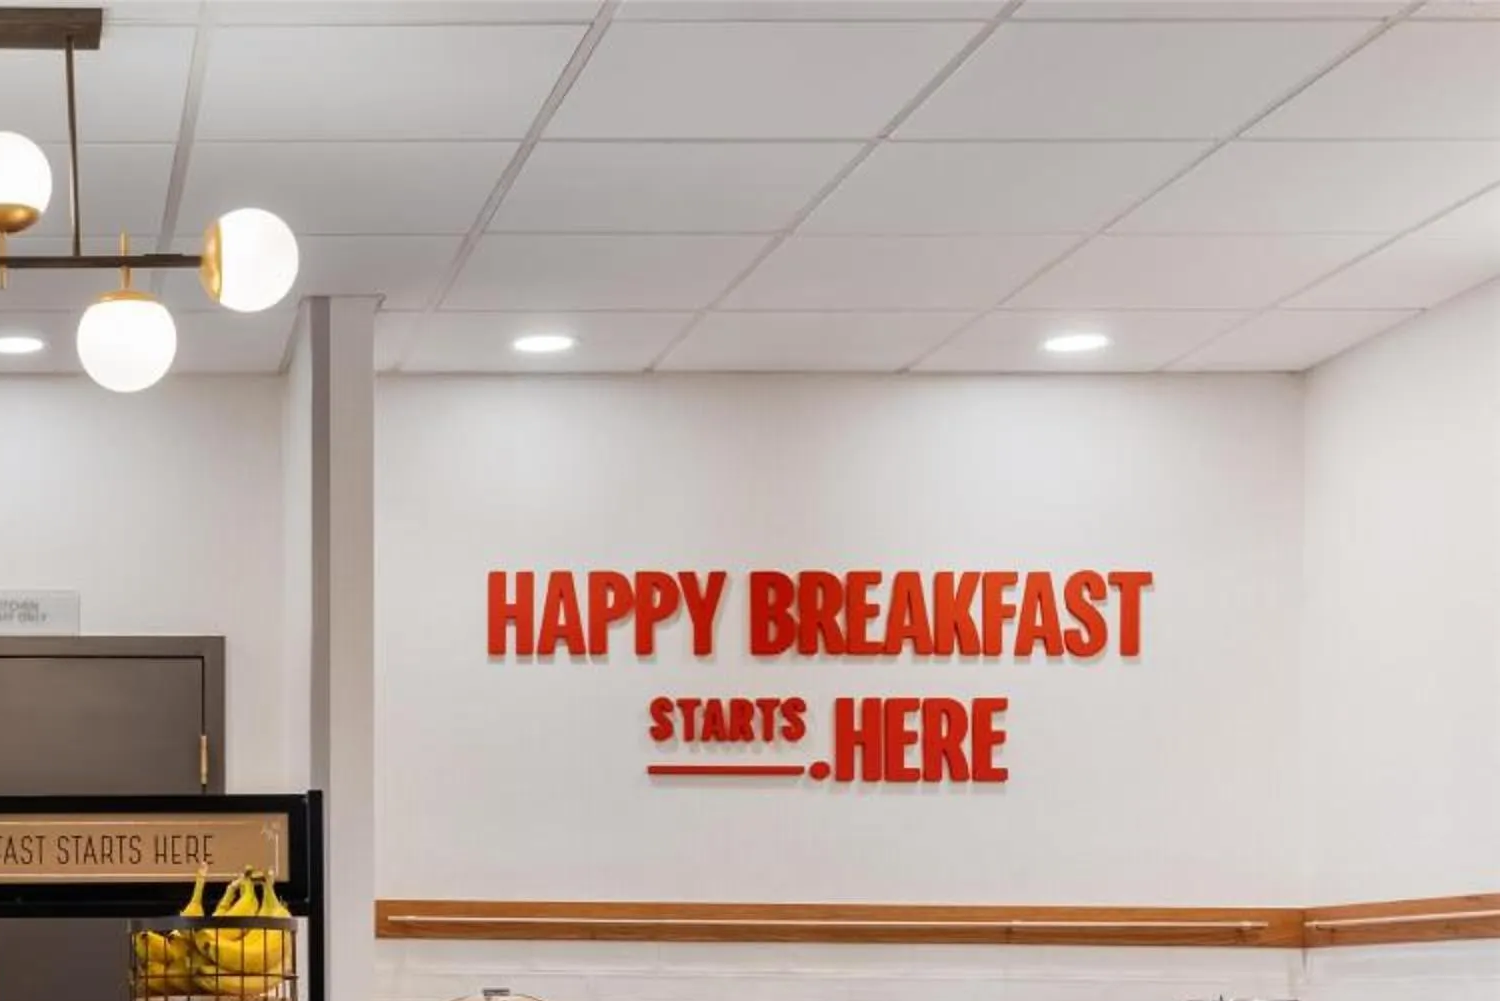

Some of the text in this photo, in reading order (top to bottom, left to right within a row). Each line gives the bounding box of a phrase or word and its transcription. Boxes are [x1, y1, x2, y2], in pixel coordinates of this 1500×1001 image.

[488, 570, 1152, 657] HAPPY BREAKFAST
[649, 696, 806, 742] STARTS
[56, 834, 143, 865] STARTS
[154, 834, 215, 865] HERE
